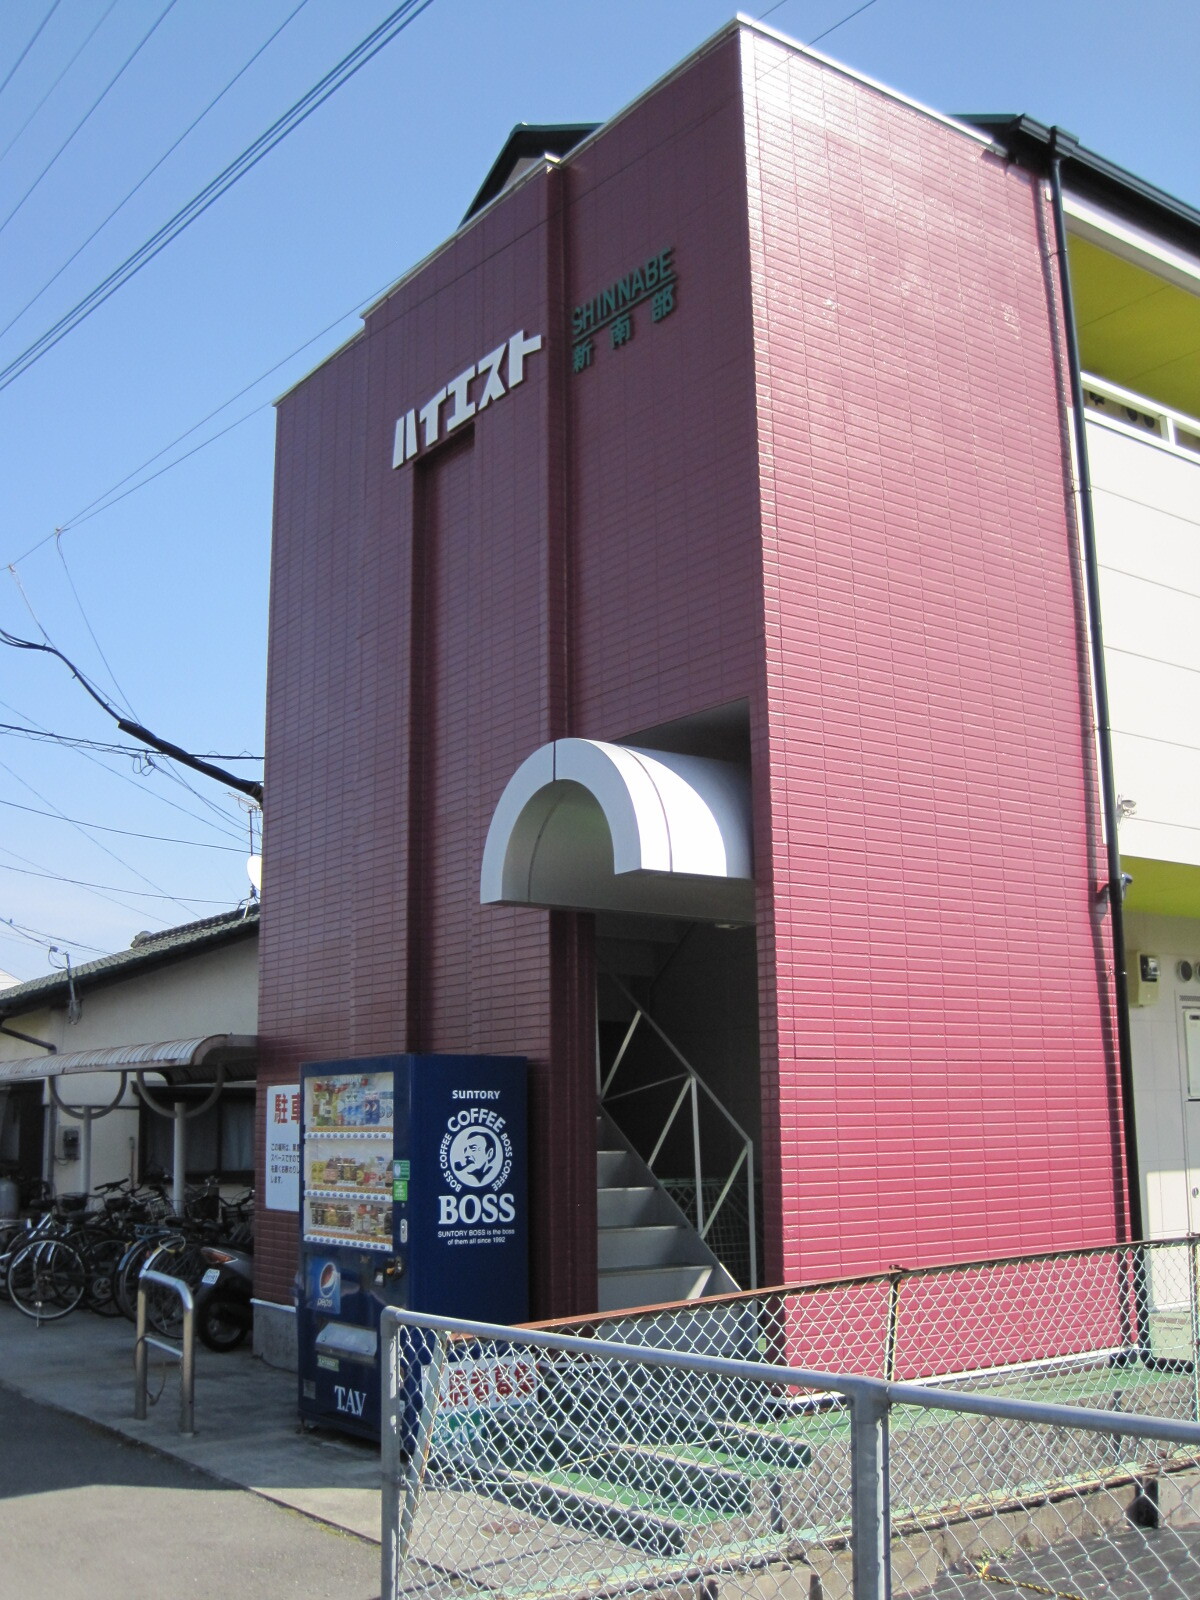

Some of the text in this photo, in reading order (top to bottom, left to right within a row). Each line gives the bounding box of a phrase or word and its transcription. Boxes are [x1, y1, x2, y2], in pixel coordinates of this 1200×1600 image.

[571, 248, 675, 336] SHINNABE
[571, 283, 675, 374] 新南部
[392, 329, 542, 470] ハイエスト
[447, 1108, 506, 1132] COFFEE
[440, 1133, 462, 1192] BOSS COFFEE
[492, 1133, 513, 1191] BOSS COFFEE
[437, 1230, 467, 1238] SUNTORY
[492, 1228, 502, 1236] the
[438, 1193, 516, 1225] BOSS
[438, 1361, 536, 1408] 居者募集
